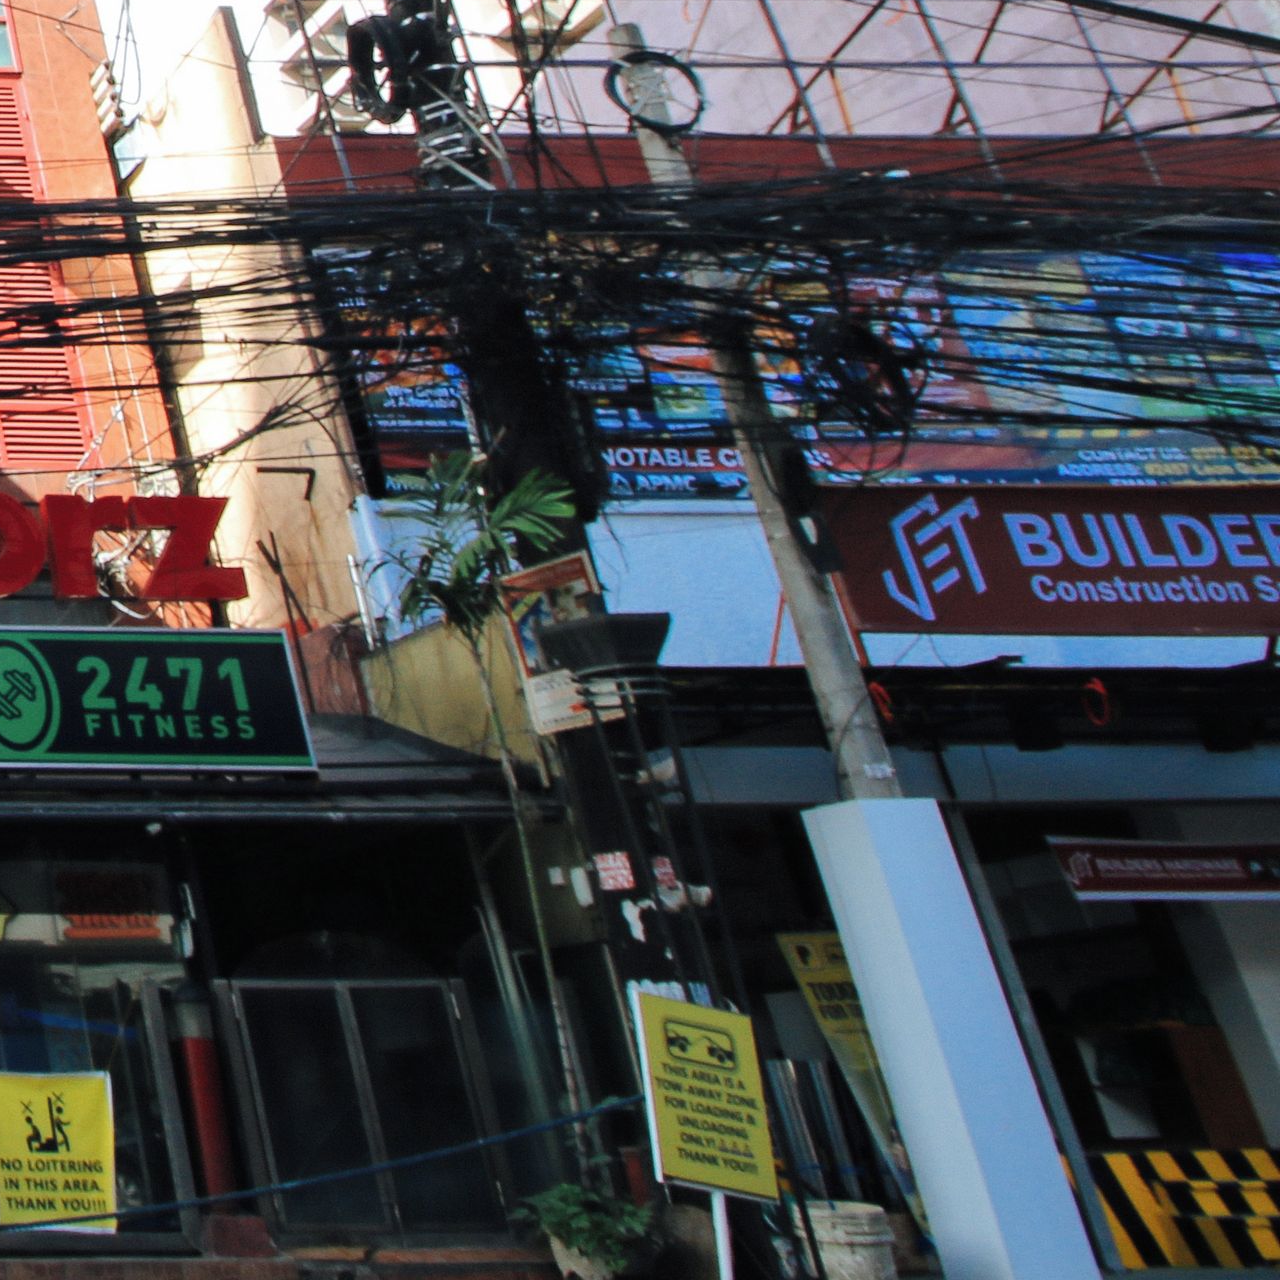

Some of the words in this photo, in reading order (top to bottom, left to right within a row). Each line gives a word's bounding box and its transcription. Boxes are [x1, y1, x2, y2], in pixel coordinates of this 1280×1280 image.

[601, 448, 713, 468] NOTABLE
[1030, 573, 1250, 603] Construction
[76, 656, 252, 713] 2471
[83, 713, 258, 739] FITNESS
[661, 1063, 689, 1080] THIS
[691, 1070, 721, 1086] AREA
[664, 1096, 689, 1111] FOR
[690, 1102, 744, 1124] LOADING
[676, 1115, 750, 1140] UNLOADING
[0, 1158, 23, 1171] NO
[27, 1158, 104, 1173] LOITERING
[676, 1147, 720, 1167] THANK
[4, 1178, 20, 1191] IN
[24, 1178, 58, 1191] THIS
[63, 1179, 104, 1193] AREA.
[5, 1197, 57, 1211] THANK
[60, 1198, 108, 1213] YOU!!!
